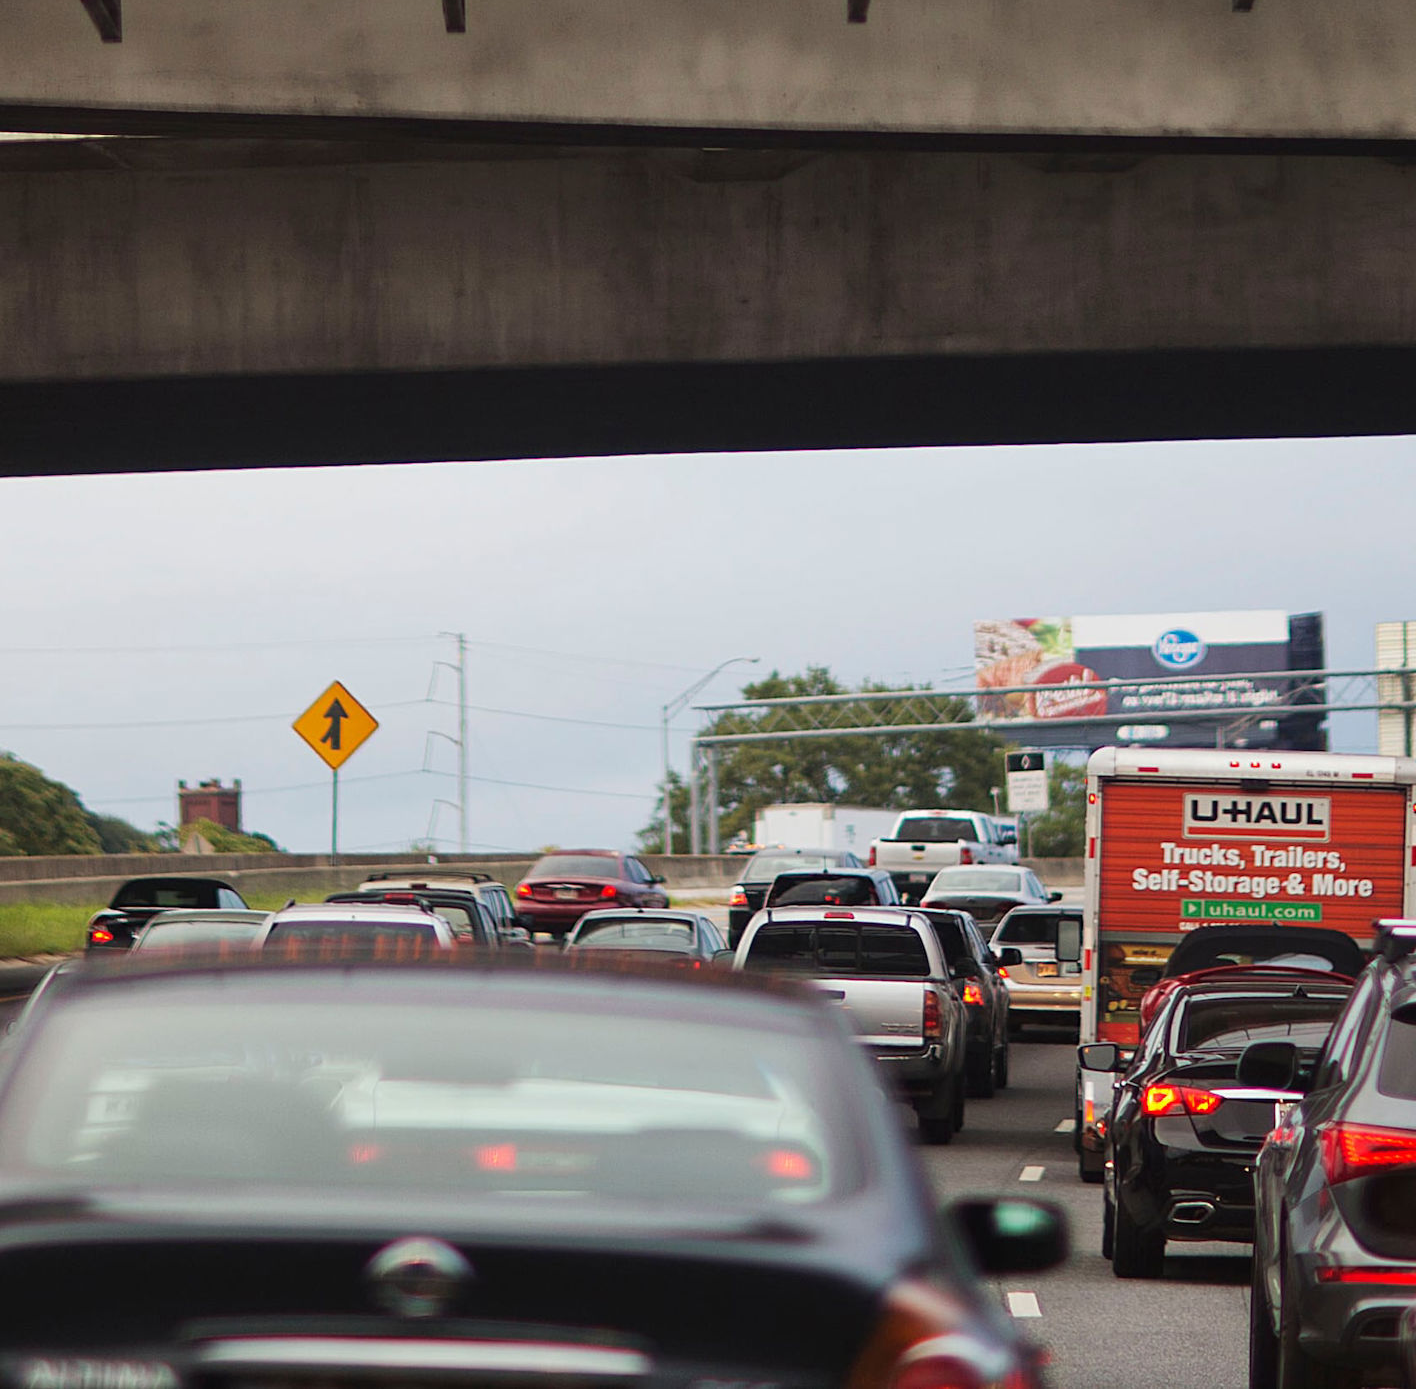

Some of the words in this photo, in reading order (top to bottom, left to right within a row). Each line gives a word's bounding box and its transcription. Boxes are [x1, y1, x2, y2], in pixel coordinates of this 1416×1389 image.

[1190, 799, 1324, 825] U-HAUL
[1160, 842, 1246, 871] Trucks,
[1250, 844, 1346, 872] Trailers,
[1132, 868, 1286, 898] Self-Storage
[1286, 874, 1305, 896] &
[1312, 873, 1373, 897] More
[1209, 902, 1317, 919] uhaul.com
